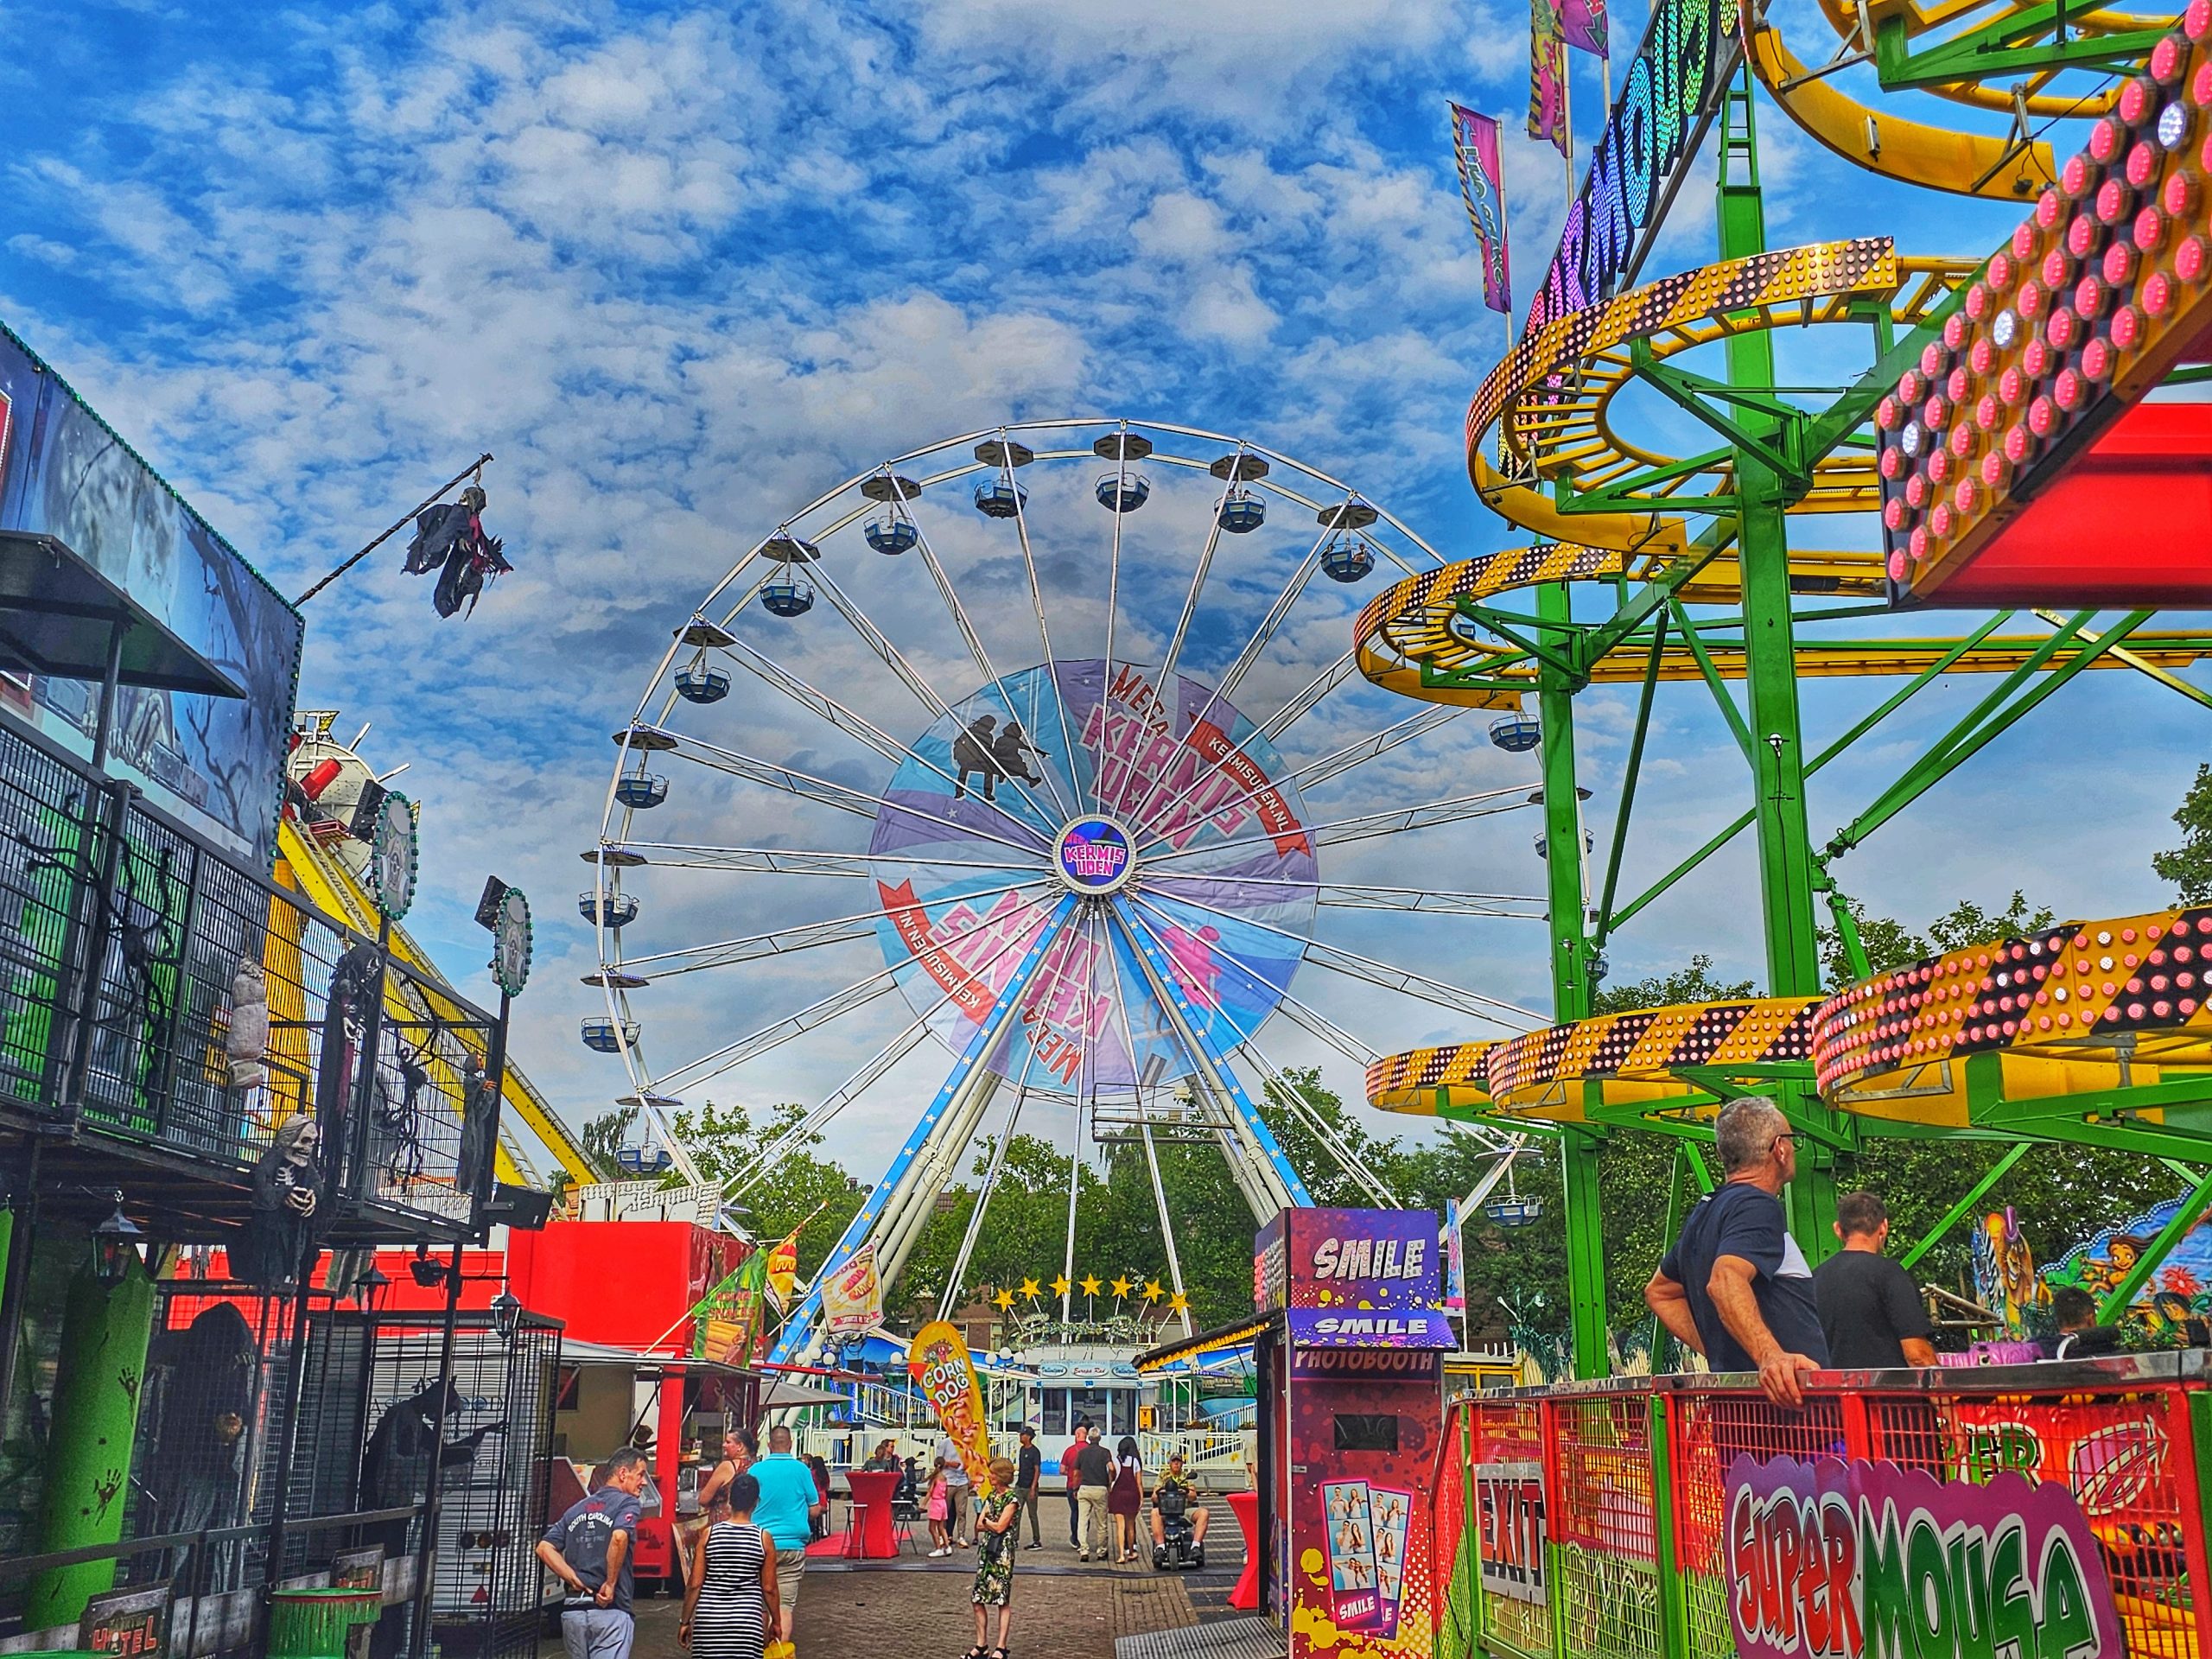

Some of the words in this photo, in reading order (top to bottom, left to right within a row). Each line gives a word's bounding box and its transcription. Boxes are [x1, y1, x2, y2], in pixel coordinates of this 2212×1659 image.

[1108, 664, 1169, 738] MEGA
[1079, 702, 1262, 839] KERMIS
[1209, 737, 1289, 832] KERMISUDEN.NL
[1087, 754, 1206, 851] UDEN
[1065, 844, 1126, 864] KERMIS
[1077, 860, 1114, 876] UDEN
[1022, 1006, 1088, 1086] MEGA
[1313, 1237, 1426, 1281] SMILE
[1314, 1318, 1428, 1335] SMILE
[923, 1357, 967, 1389] CORN
[1294, 1351, 1434, 1370] PHOTOBOOTH
[934, 1372, 969, 1408] DOG
[568, 1513, 587, 1533] SOUTH
[588, 1512, 613, 1528] CAROLINA
[1478, 1480, 1542, 1581] EXIT
[1732, 1482, 1865, 1659] SUPER
[1338, 1595, 1376, 1620] SMILE
